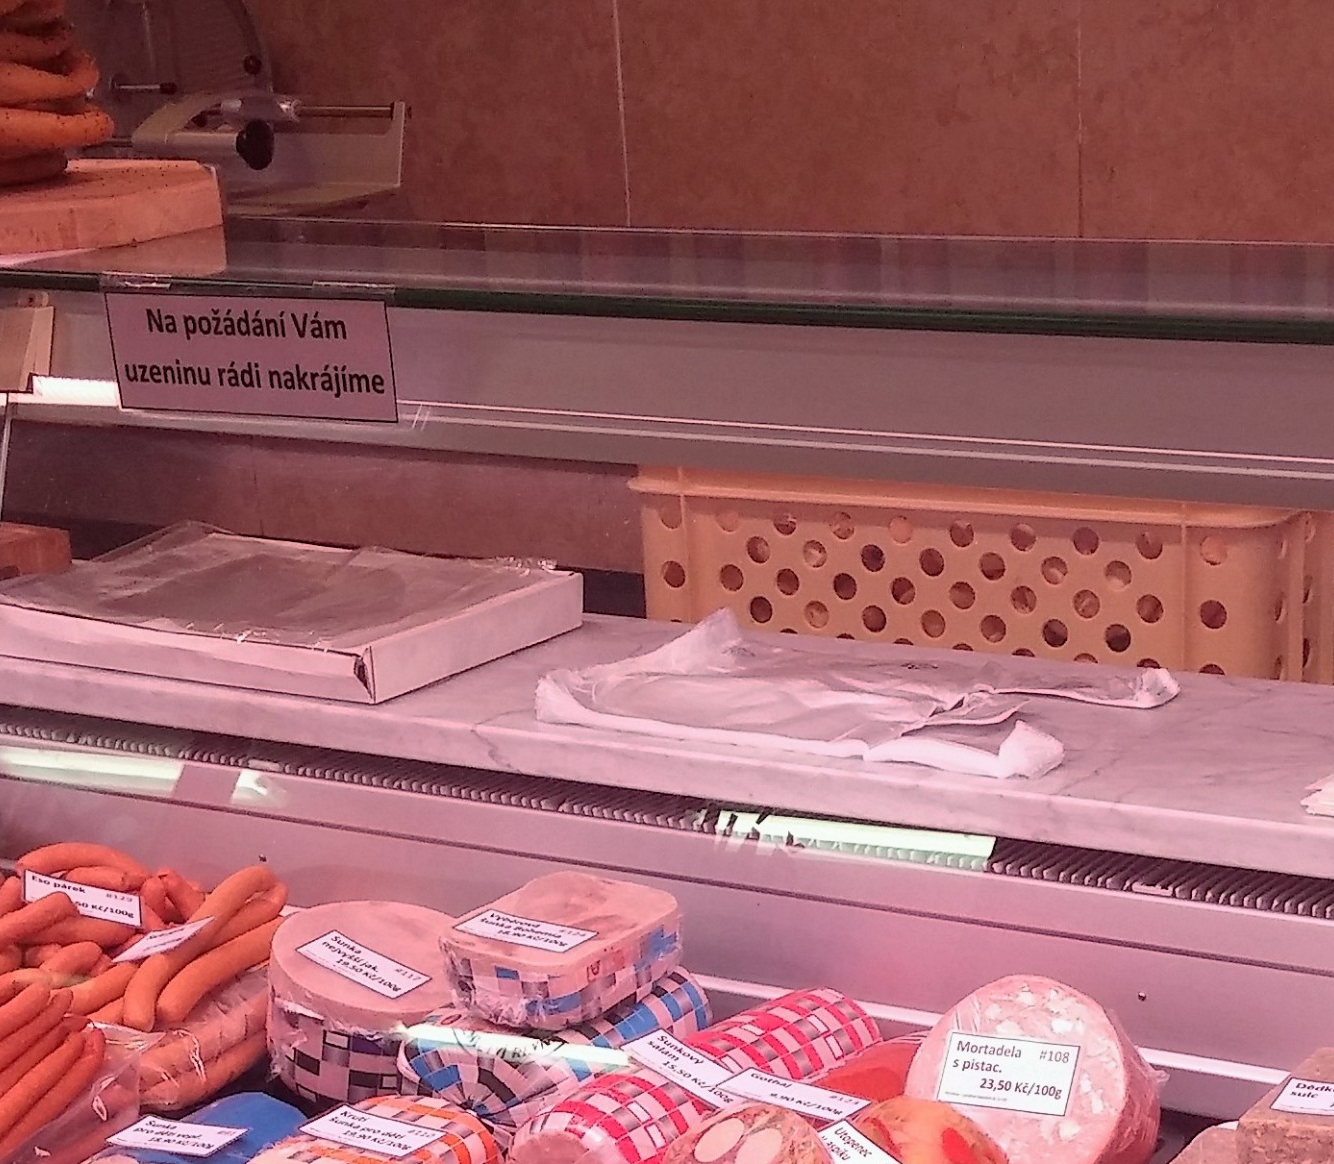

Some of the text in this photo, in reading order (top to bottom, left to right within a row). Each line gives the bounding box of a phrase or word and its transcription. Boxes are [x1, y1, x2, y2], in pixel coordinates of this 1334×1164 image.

[146, 308, 348, 341] Na požádání Vám
[124, 359, 386, 398] uzeninu rádi nakrájíme
[957, 1040, 1070, 1064] Mortadela #108
[953, 1058, 1002, 1074] s pistac.
[980, 1078, 1063, 1100] 23,50 Kč/100g
